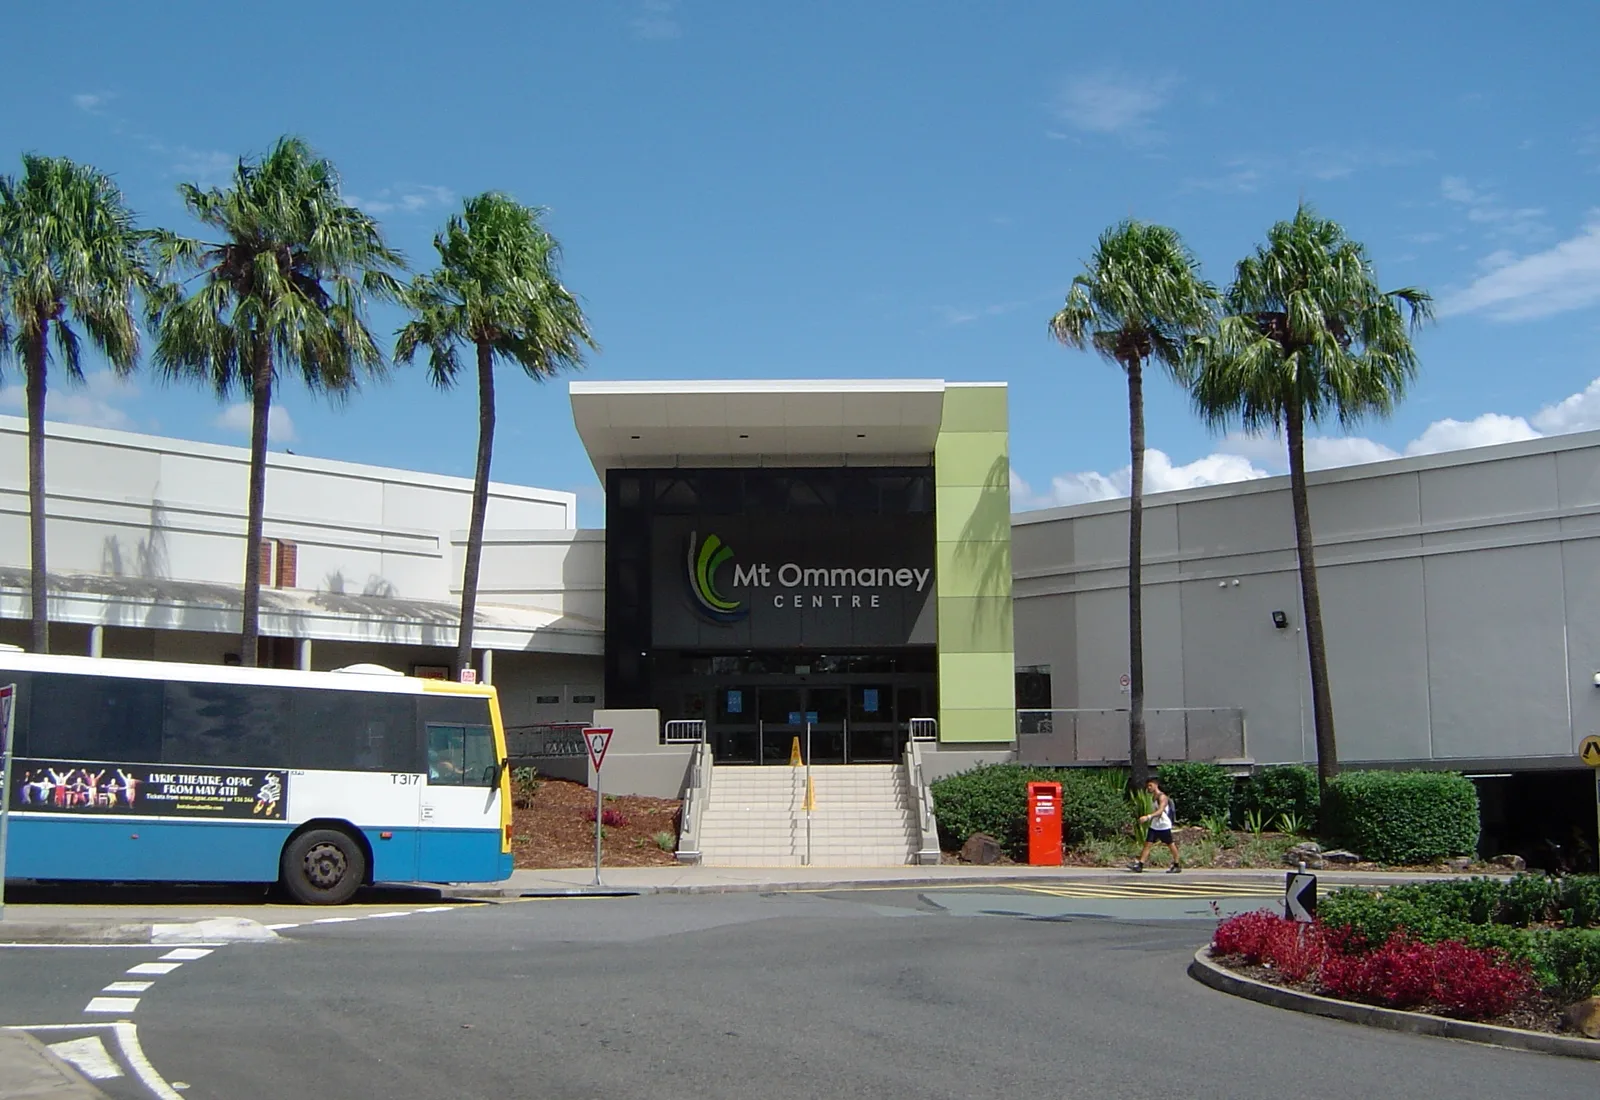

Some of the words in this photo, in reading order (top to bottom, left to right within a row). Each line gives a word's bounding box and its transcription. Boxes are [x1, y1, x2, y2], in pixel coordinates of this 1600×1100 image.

[733, 563, 771, 587] Mt
[777, 563, 930, 591] Ommaney
[773, 595, 880, 608] CENTRE
[149, 773, 177, 784] LYRIC
[178, 774, 224, 786] THEATRE,
[390, 773, 420, 785] T317
[163, 784, 194, 794] FROM
[195, 785, 217, 796] MAY
[218, 786, 238, 796] 4TH
